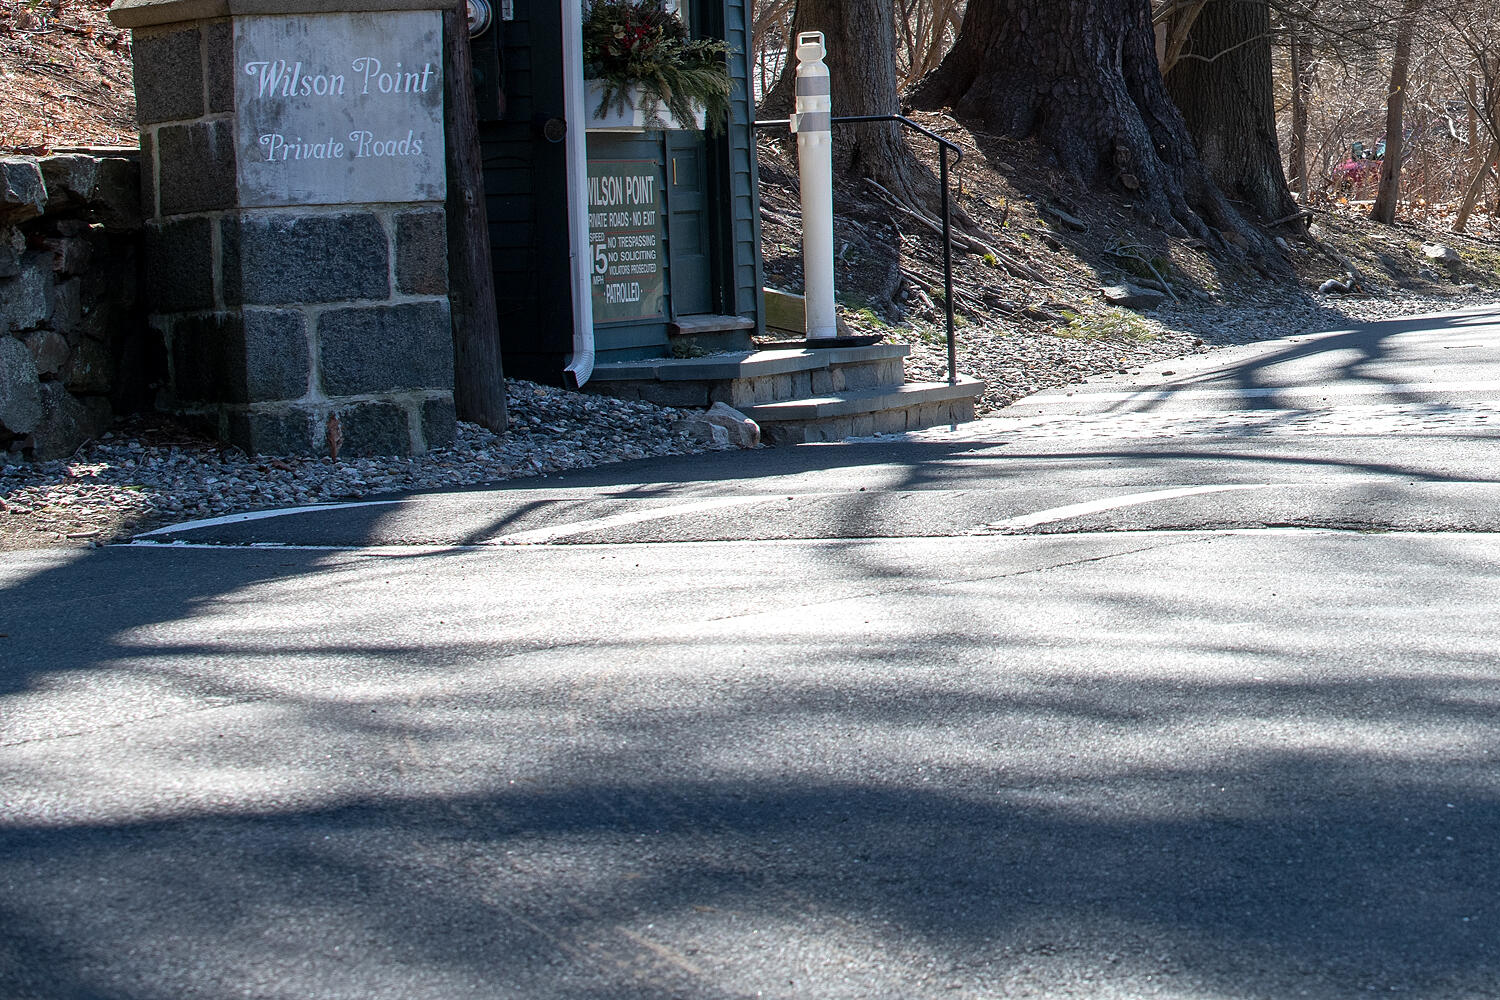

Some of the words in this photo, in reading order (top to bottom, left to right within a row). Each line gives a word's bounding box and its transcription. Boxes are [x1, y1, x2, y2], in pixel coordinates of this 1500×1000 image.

[245, 59, 345, 98] Wilson
[351, 56, 434, 96] Point
[259, 132, 345, 162] Private
[348, 129, 423, 158] Roads
[626, 175, 654, 205] POINT
[589, 212, 607, 228] RIVATE
[609, 211, 629, 227] ROADS
[632, 211, 642, 226] NO
[643, 210, 656, 226] EXIT
[589, 232, 605, 242] SPEED
[607, 236, 617, 249] NO
[618, 234, 656, 248] TRESPASSING
[589, 243, 609, 275] 15
[608, 251, 618, 262] NO
[620, 250, 656, 261] SOLICITING
[609, 264, 630, 276] VIOLATORS
[631, 263, 657, 275] PROSECUTED
[593, 275, 605, 285] MPH
